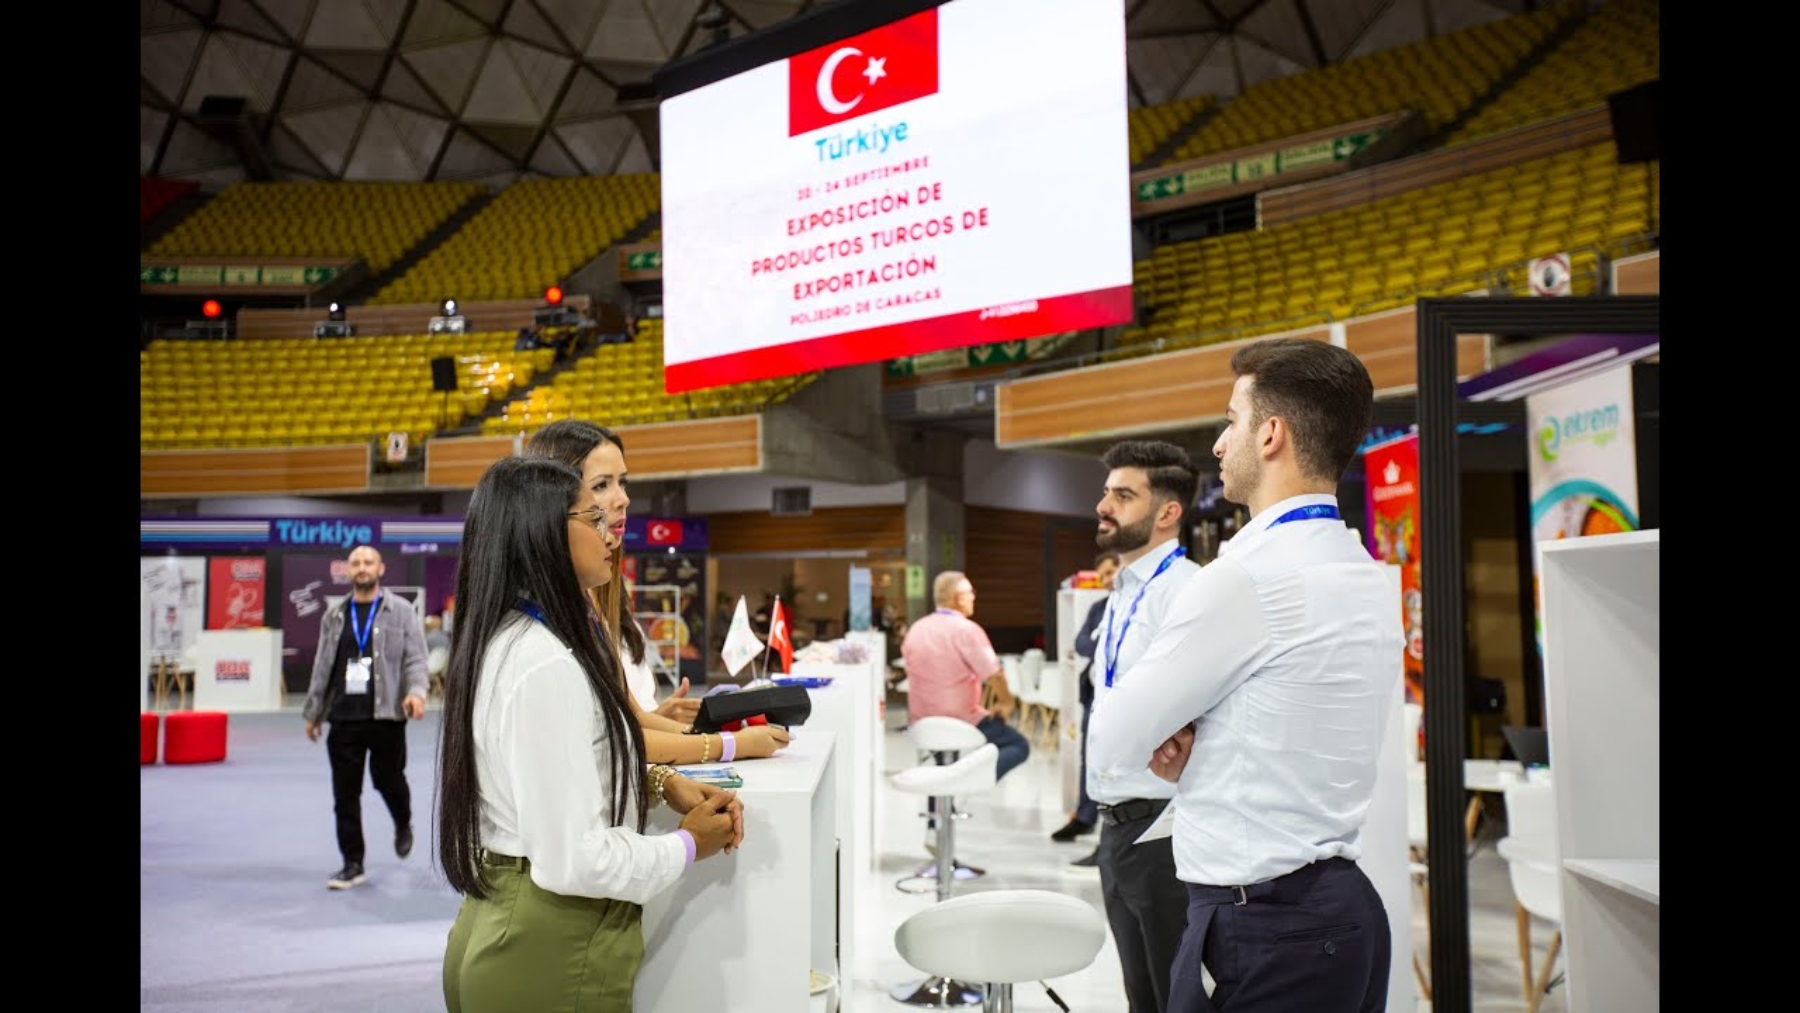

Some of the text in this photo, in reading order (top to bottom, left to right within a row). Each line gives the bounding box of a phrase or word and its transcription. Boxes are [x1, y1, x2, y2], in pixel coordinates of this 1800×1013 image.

[814, 121, 909, 162] Türkiye
[844, 156, 929, 188] SEPTIEMBRE
[786, 182, 942, 237] EXPOSICIÓN DE
[751, 207, 989, 276] PRODUCTOS TURCOS DE
[793, 253, 936, 300] EXPORTACIÓN
[789, 288, 941, 325] POLIEDRO DE CARACAS
[276, 519, 372, 548] Türkiye
